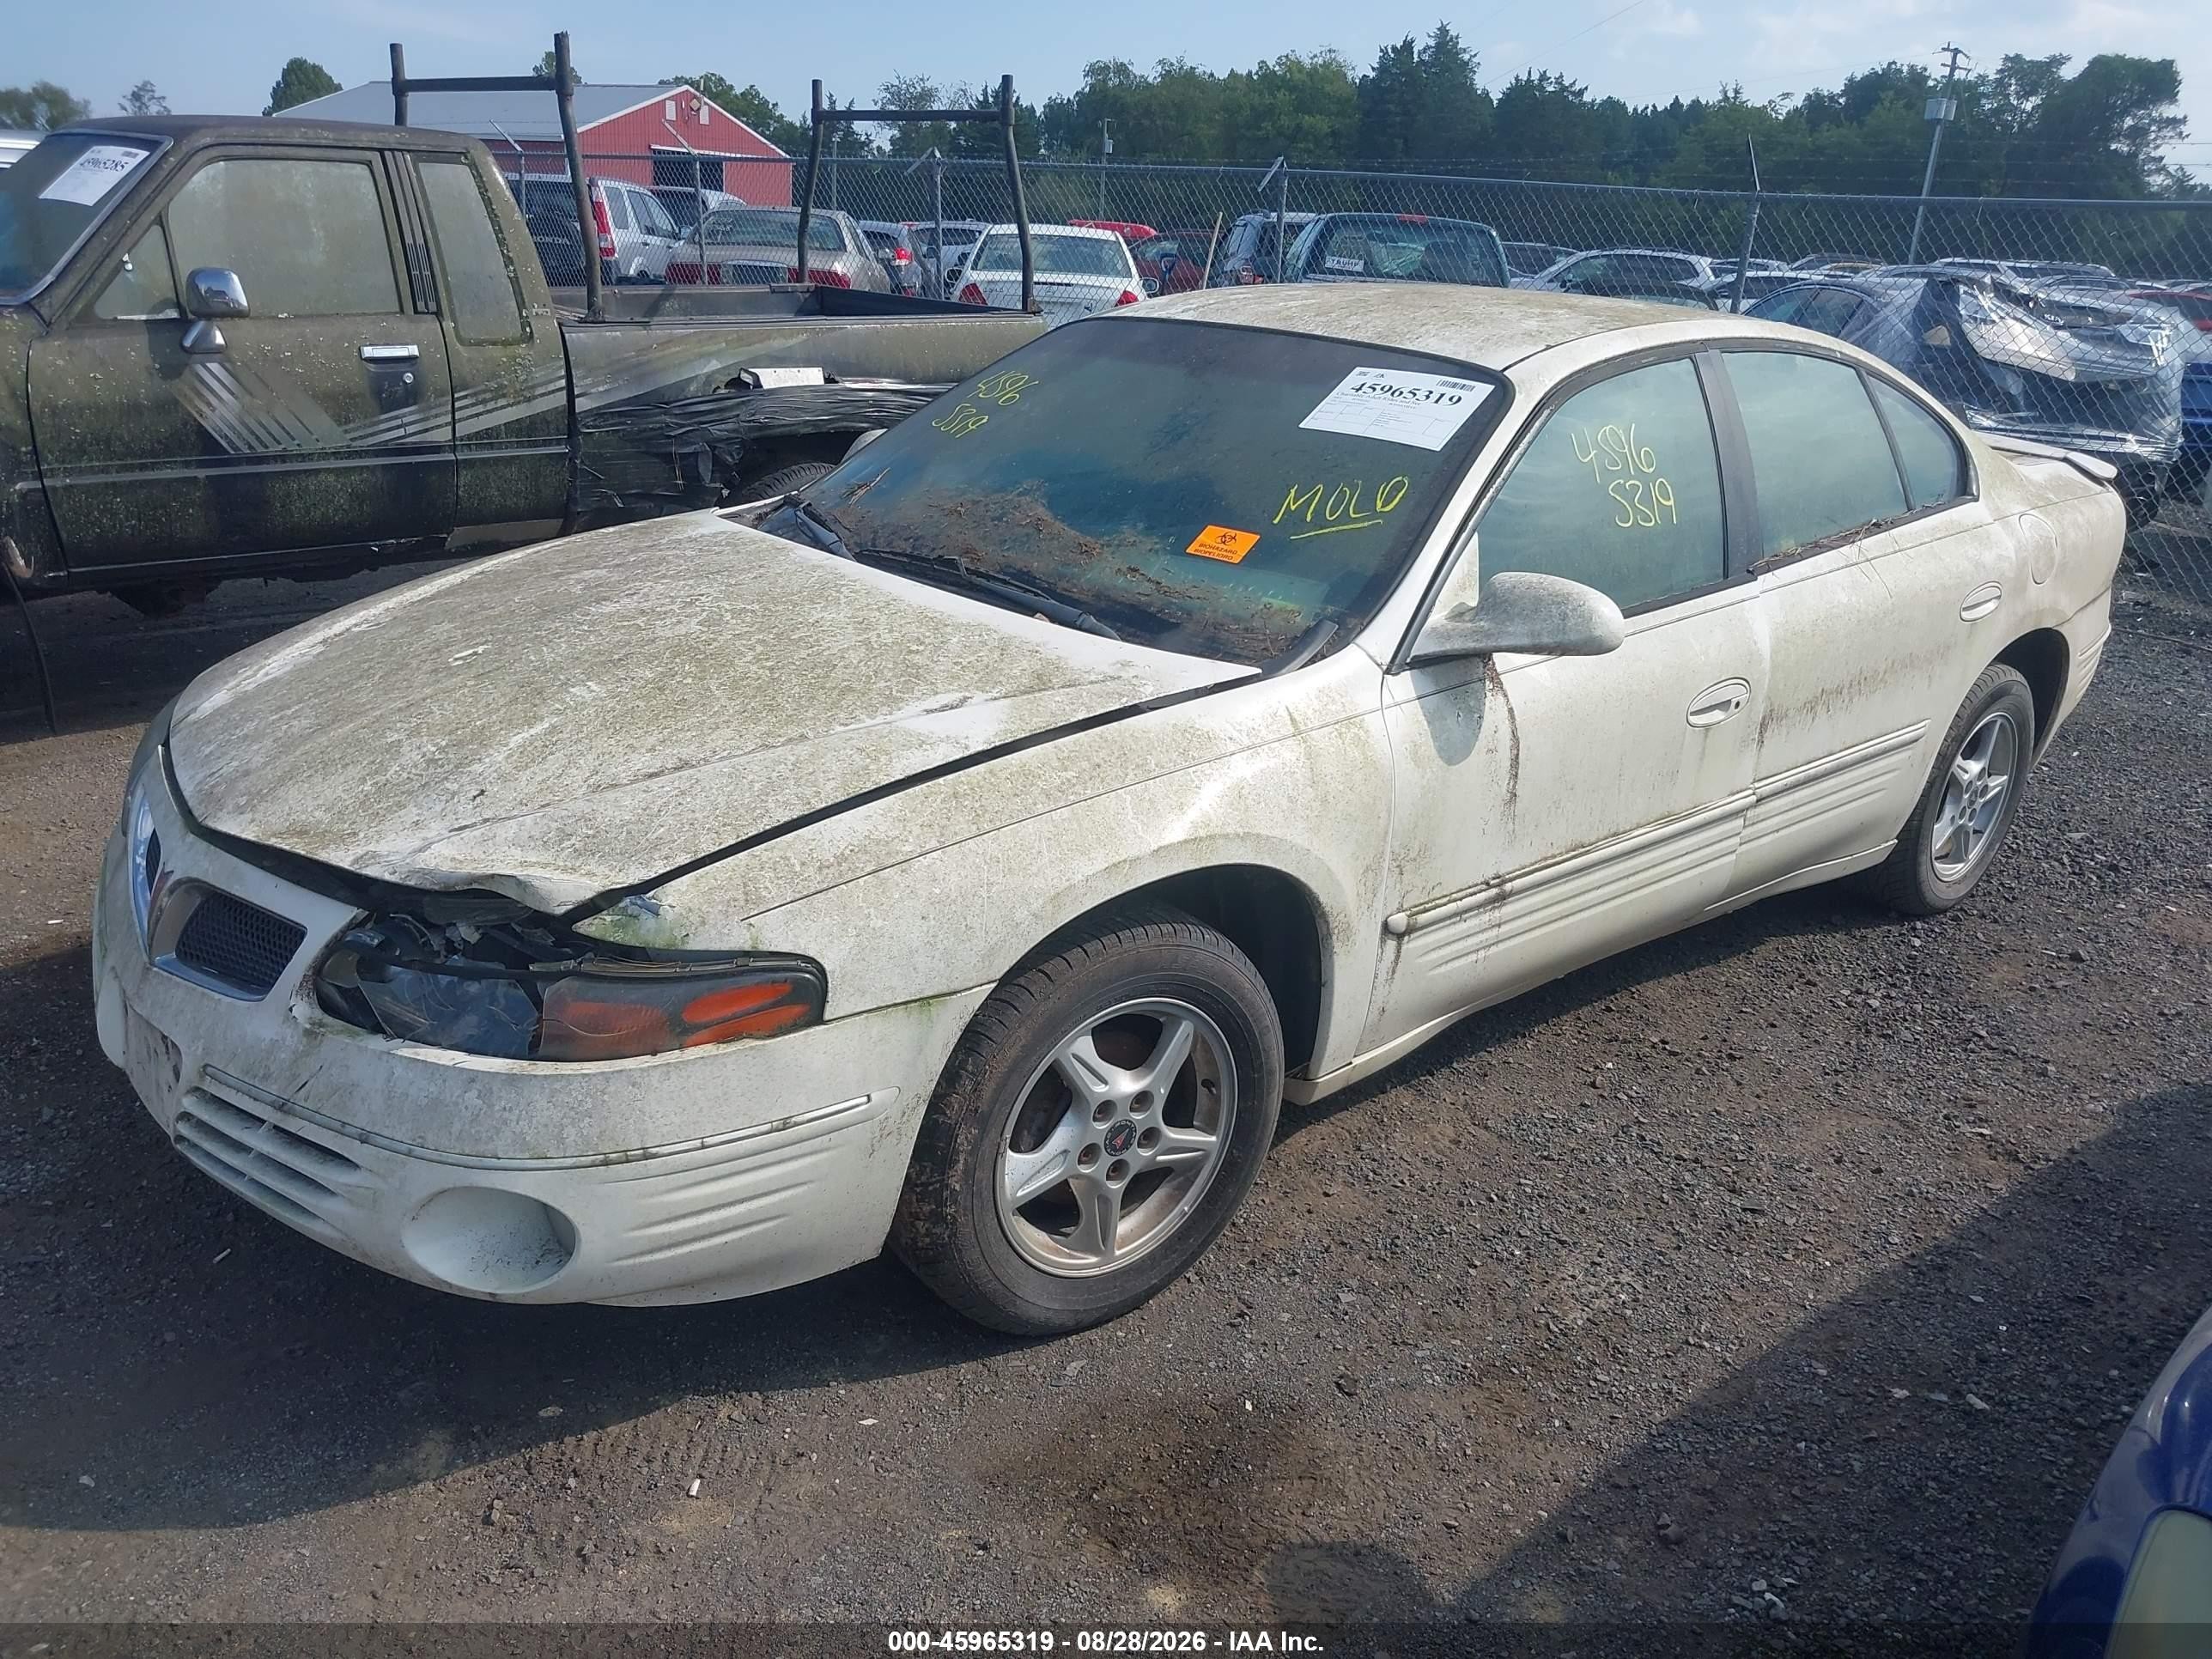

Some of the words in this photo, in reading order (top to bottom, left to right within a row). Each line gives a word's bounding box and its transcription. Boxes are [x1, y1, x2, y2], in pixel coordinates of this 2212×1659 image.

[1350, 381, 1462, 406] 45965319
[1571, 422, 1656, 483] 4596
[1271, 475, 1409, 525] MOLD
[1608, 477, 1677, 528] 5319
[1194, 548, 1234, 561] BIOPELIGRO
[1198, 543, 1238, 555] BIOHAZARD
